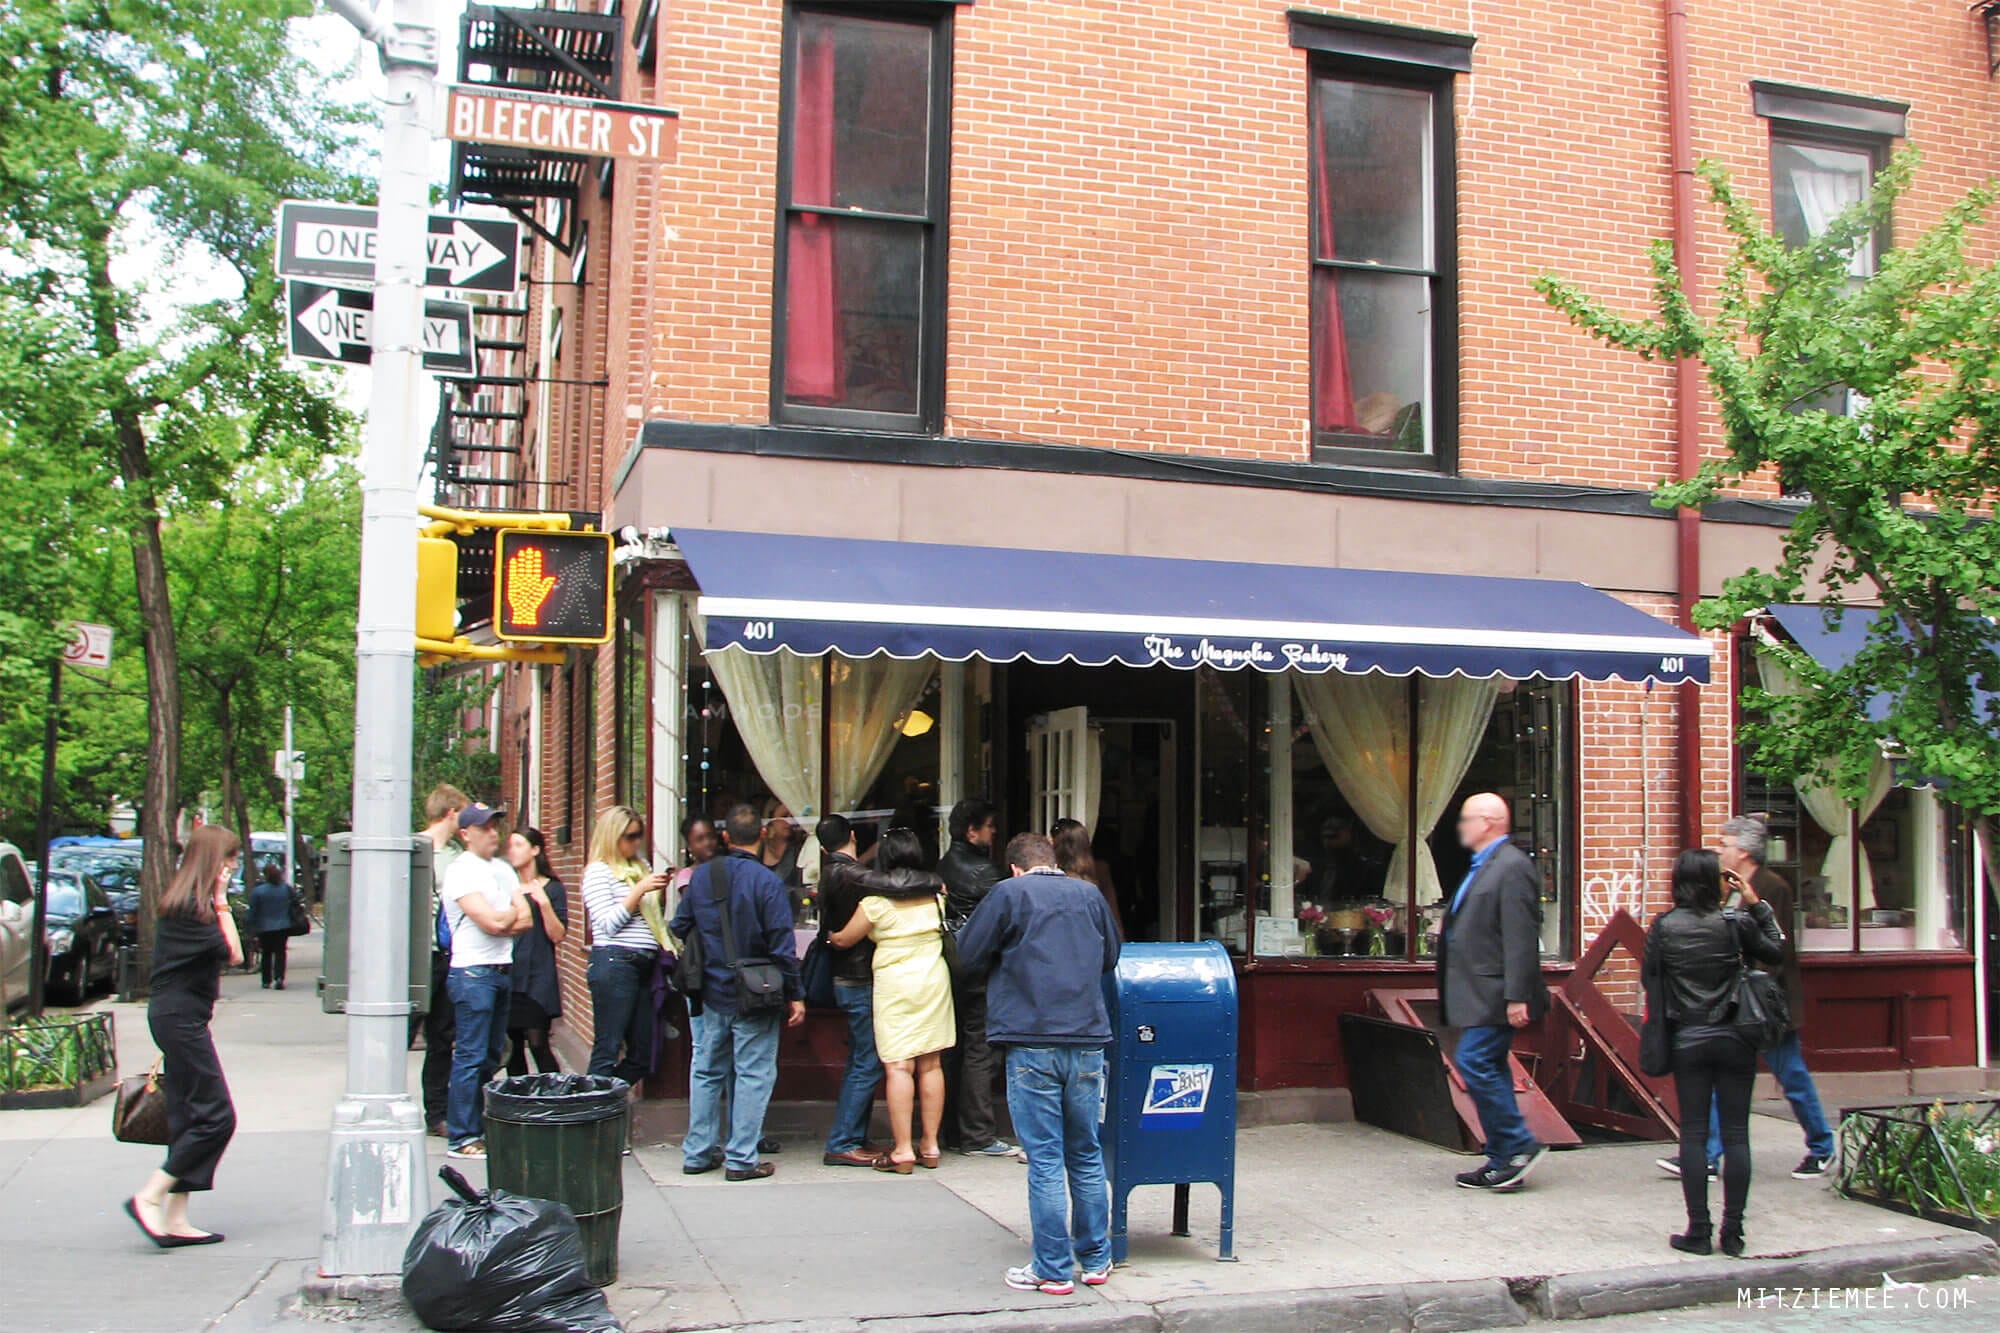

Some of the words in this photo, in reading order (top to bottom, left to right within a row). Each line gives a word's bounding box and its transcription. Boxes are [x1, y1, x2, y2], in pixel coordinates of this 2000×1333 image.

[454, 95, 612, 152] BLEECKER
[628, 115, 664, 158] ST
[316, 228, 377, 258] ONE
[317, 308, 366, 341] ONE
[743, 621, 774, 640] 401
[1144, 634, 1184, 659] The
[1191, 638, 1275, 666] Magnolia
[1281, 641, 1350, 670] Bakery
[1660, 656, 1684, 673] 401
